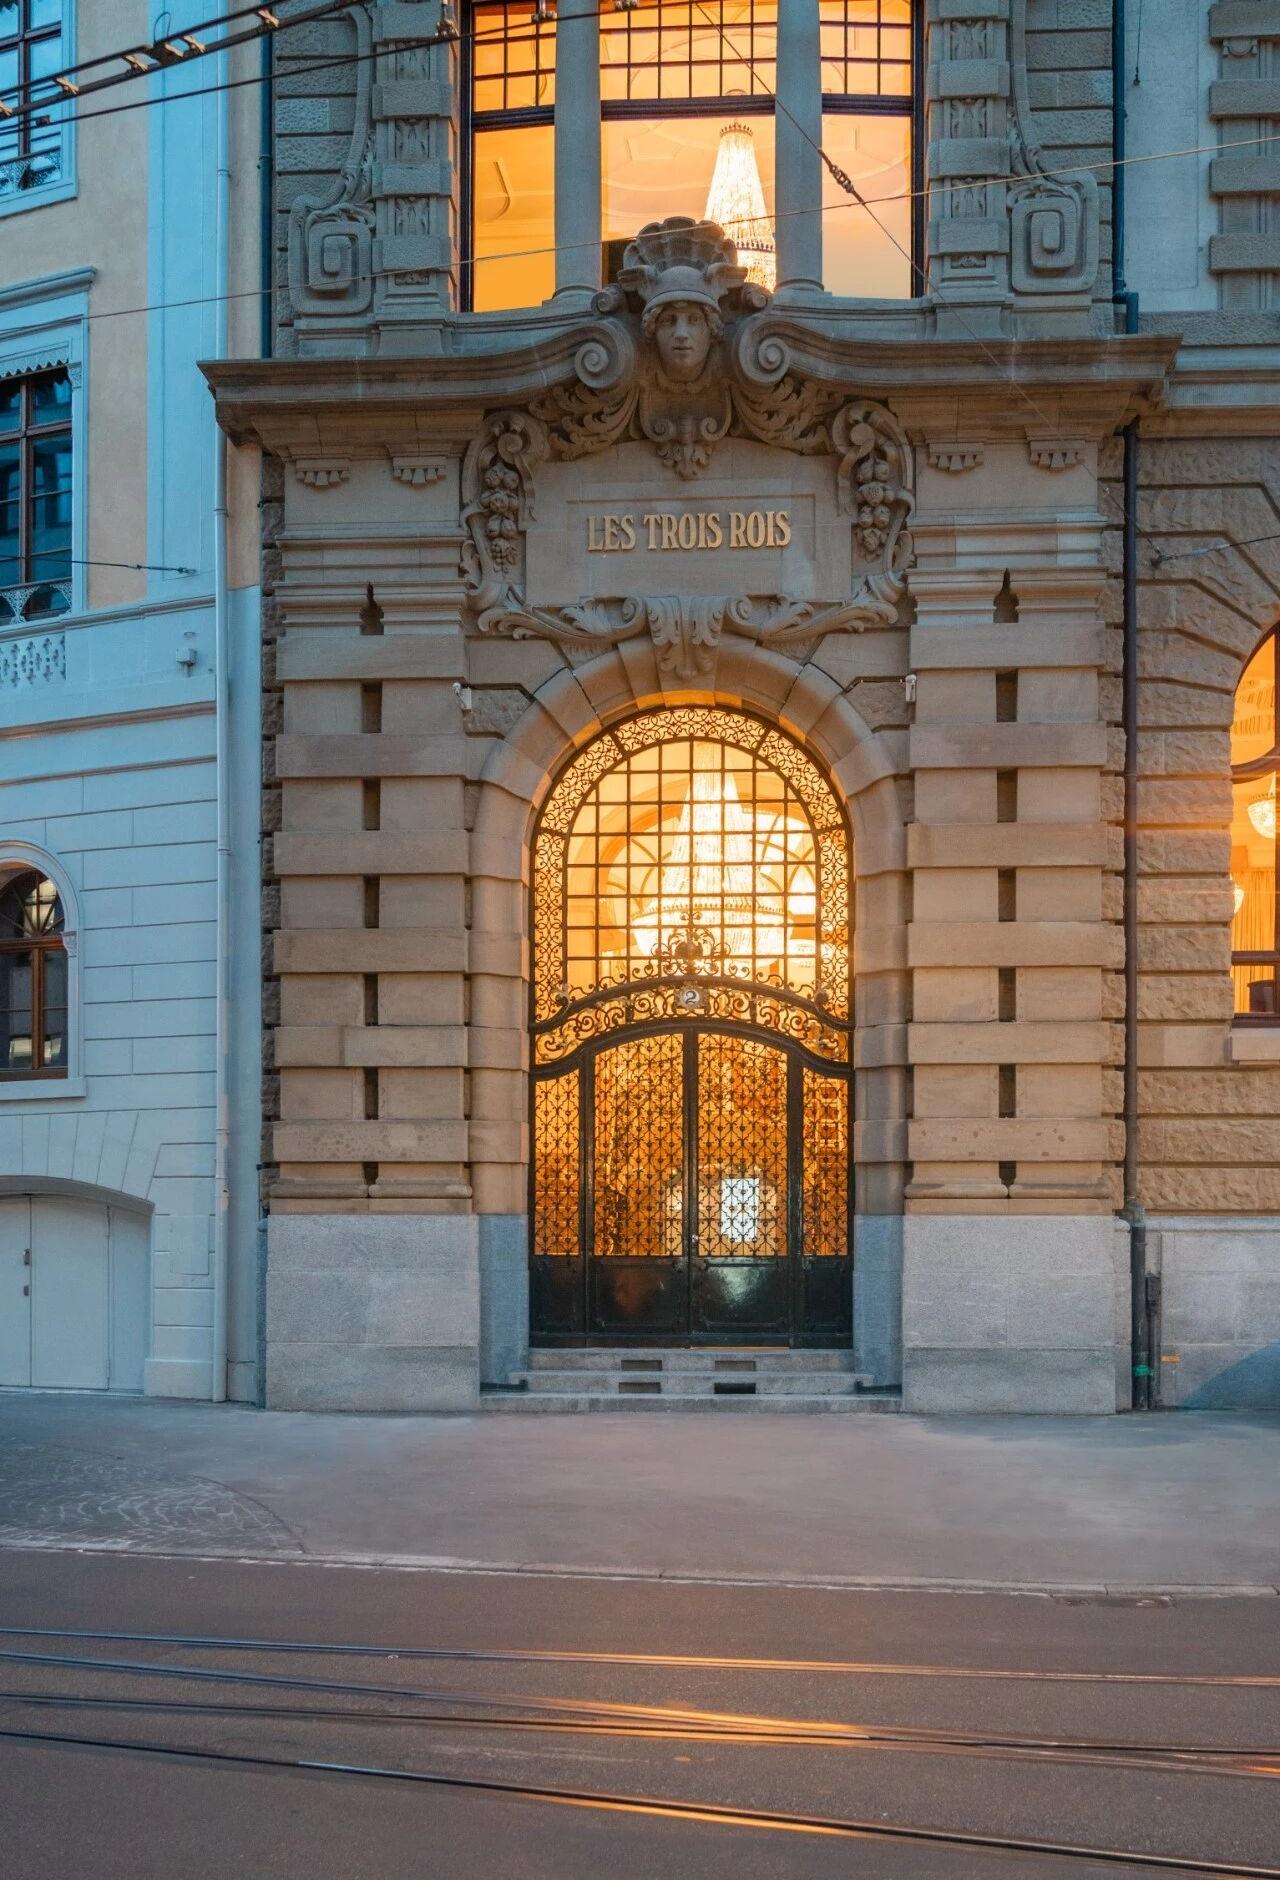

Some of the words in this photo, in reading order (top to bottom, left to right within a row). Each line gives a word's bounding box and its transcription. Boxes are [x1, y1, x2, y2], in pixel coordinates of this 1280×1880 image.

[587, 514, 637, 551] LES
[643, 512, 723, 550] TROIS
[729, 510, 792, 549] ROIS
[685, 990, 697, 1005] 2
